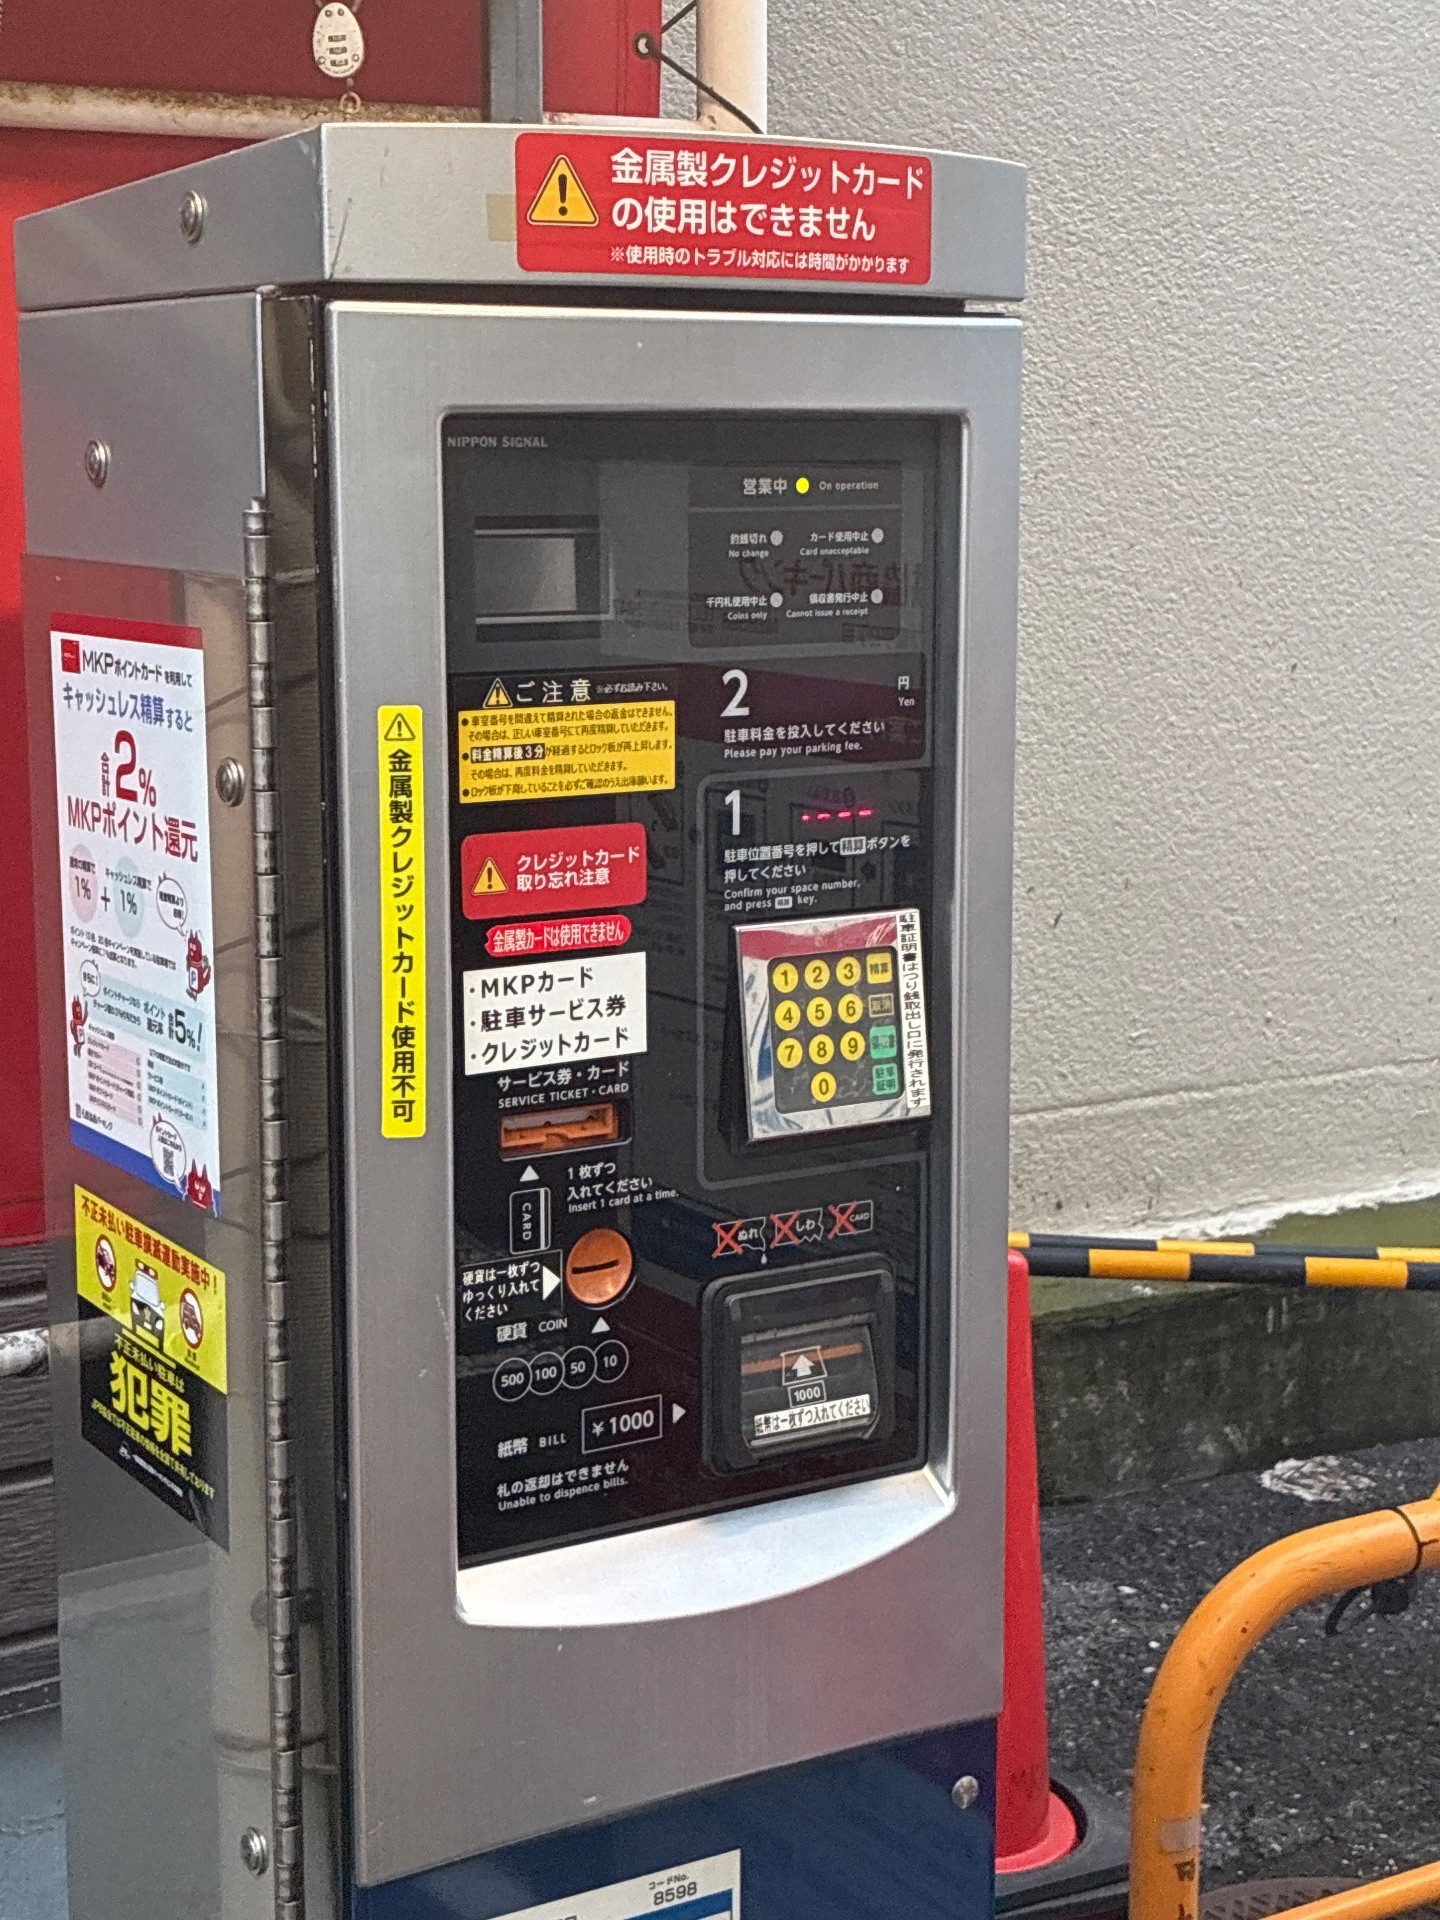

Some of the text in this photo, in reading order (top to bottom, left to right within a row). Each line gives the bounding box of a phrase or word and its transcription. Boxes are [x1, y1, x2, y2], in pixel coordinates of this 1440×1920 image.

[610, 146, 925, 201] 金属製クレジットカード
[611, 197, 876, 243] の使用はできません
[609, 245, 910, 276] ※使用時のトラブル対応には時間がかかります
[447, 435, 549, 448] NIPPON SIGNAL
[743, 478, 788, 495] 営業中
[818, 481, 879, 492] On operation
[730, 533, 768, 546] 釣銭切れ
[809, 531, 869, 543] カード使用中止
[728, 549, 770, 559] No change
[800, 547, 869, 556] Card unacceptable
[706, 596, 768, 608] 千円札使用中止
[786, 609, 813, 618] Cannot
[815, 608, 833, 616] issue
[842, 607, 869, 616] receipt
[727, 611, 768, 621] Coins only
[82, 650, 163, 685] MKPポイントカード
[516, 678, 591, 703] ご注意
[719, 669, 750, 717] 2
[898, 676, 910, 690] 円
[62, 682, 193, 732] キャッシュレス精算すると
[898, 697, 915, 707] Yen
[724, 721, 885, 743] 駐車料金を投入してください
[724, 741, 863, 759] Please pay your parking fee.
[114, 730, 157, 807] 2%
[724, 790, 741, 836] 1
[67, 794, 199, 861] MKPポイント還元
[516, 846, 640, 872] クレジットカード
[517, 868, 610, 892] 取り忘れ注意
[724, 865, 807, 884] 押してください
[75, 876, 91, 900] 1%
[120, 889, 137, 915] 1%
[724, 888, 763, 899] Confirm
[766, 885, 788, 896] your
[790, 882, 819, 894] space
[724, 902, 743, 911] and
[745, 900, 772, 911] press
[797, 895, 818, 905] key.
[388, 749, 417, 1123] 金属製クレジットカード使用不可
[493, 920, 624, 953] 金属製カードは使用できません
[780, 969, 790, 986] 1
[812, 966, 822, 983] 2
[844, 963, 854, 980] 3
[781, 1007, 793, 1024] 4
[814, 1004, 825, 1020] 5
[846, 1001, 856, 1017] 6
[785, 1045, 795, 1061] 7
[817, 1041, 827, 1058] 8
[848, 1038, 858, 1054] 9
[497, 1061, 629, 1092] サービス券・カード
[818, 1079, 829, 1095] 0
[498, 1094, 545, 1109] SERVICE
[567, 1177, 653, 1201] 入れてください
[568, 1202, 597, 1214] Insert
[600, 1199, 606, 1208] 1
[608, 1195, 631, 1207] card
[633, 1194, 644, 1203] at
[655, 1188, 679, 1199] time.
[522, 1202, 532, 1241] CARD
[737, 1226, 759, 1241] ぬれ
[850, 1211, 869, 1222] CARD
[462, 1261, 540, 1286] 硬貨は一枚ずつ
[462, 1279, 540, 1303] ゆっくり入れて
[464, 1302, 508, 1321] ください
[496, 1317, 568, 1342] 硬貨 COIN
[501, 1354, 618, 1387] 500 100 50 10
[110, 1350, 192, 1457] 犯罪
[793, 1385, 821, 1402] 1000
[498, 1437, 528, 1458] 紙幣
[539, 1433, 567, 1448] BILL
[496, 1459, 629, 1497] 札の返却はできません
[498, 1495, 536, 1511] Unable
[539, 1492, 551, 1502] to
[603, 1477, 629, 1489] bills.
[653, 1881, 697, 1906] 8598
